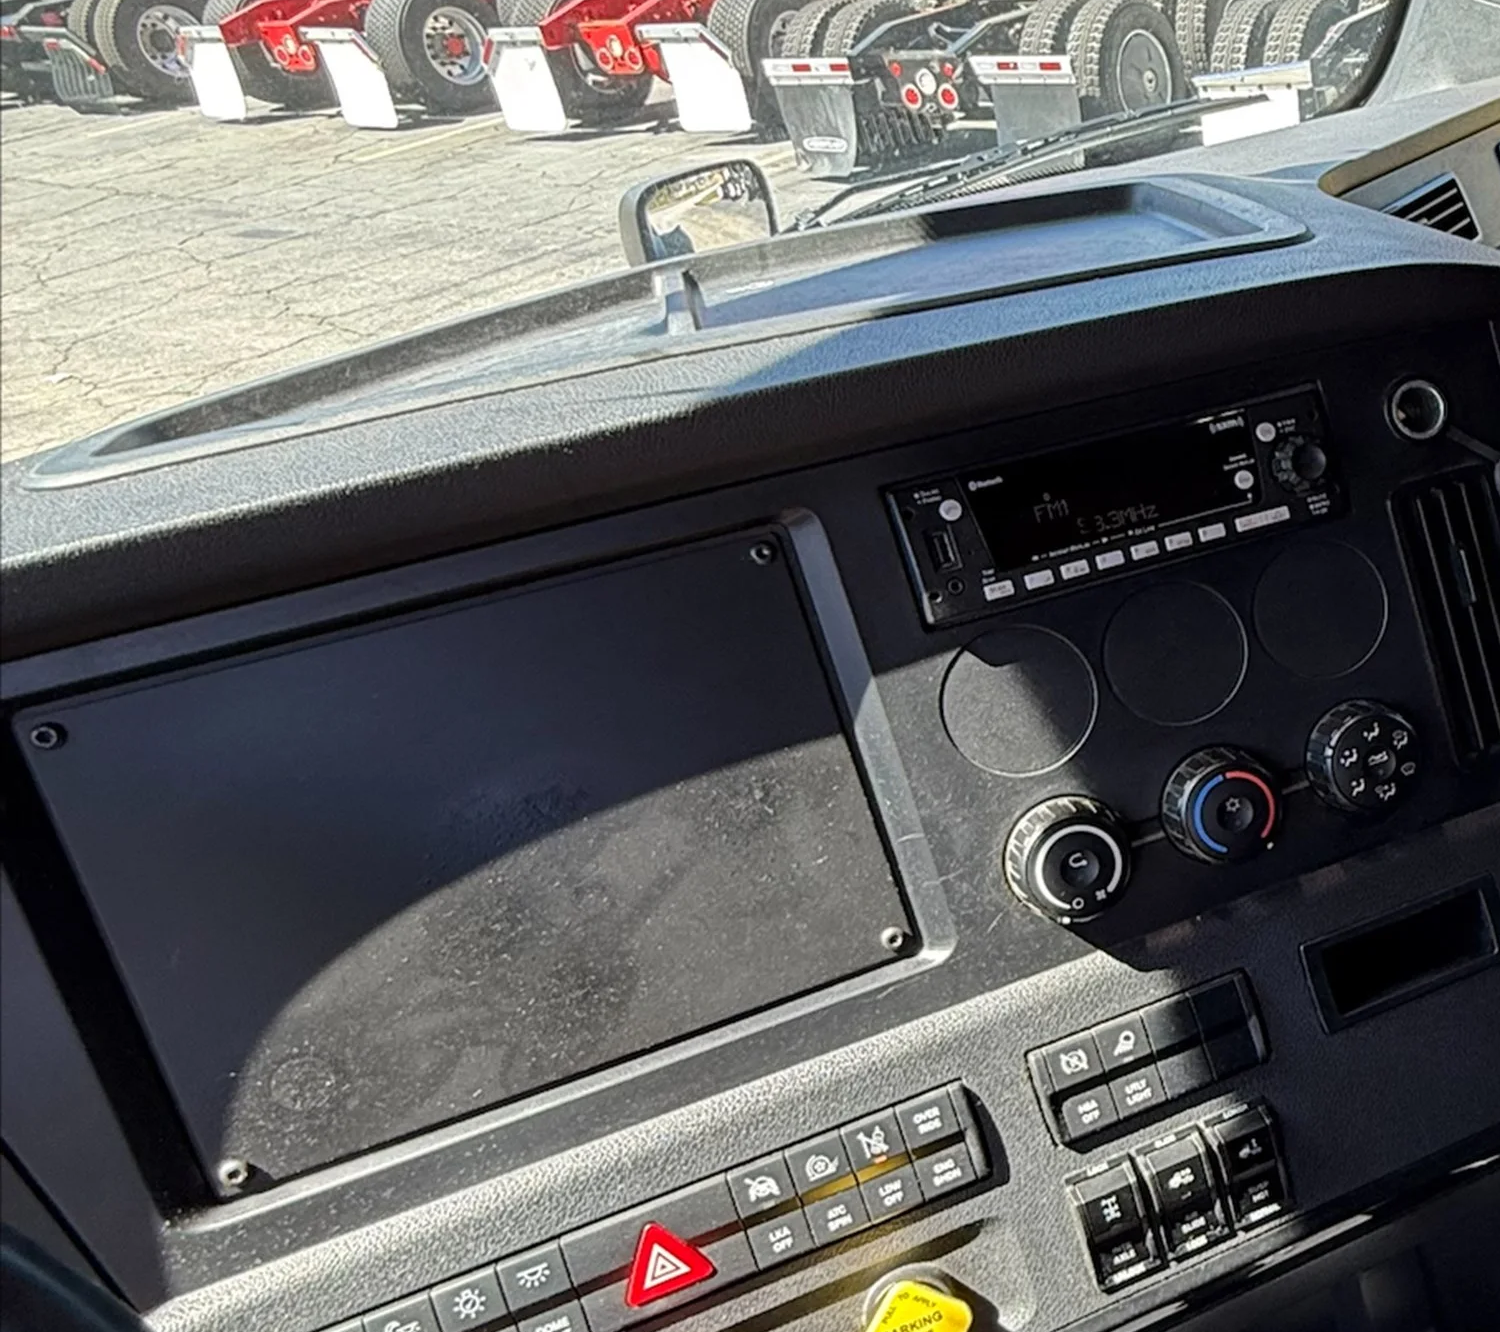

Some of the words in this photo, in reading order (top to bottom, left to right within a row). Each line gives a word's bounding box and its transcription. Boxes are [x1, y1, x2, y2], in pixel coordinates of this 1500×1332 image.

[912, 1106, 941, 1124] OVER
[883, 1190, 904, 1207] OFF
[772, 1235, 794, 1253] OFF
